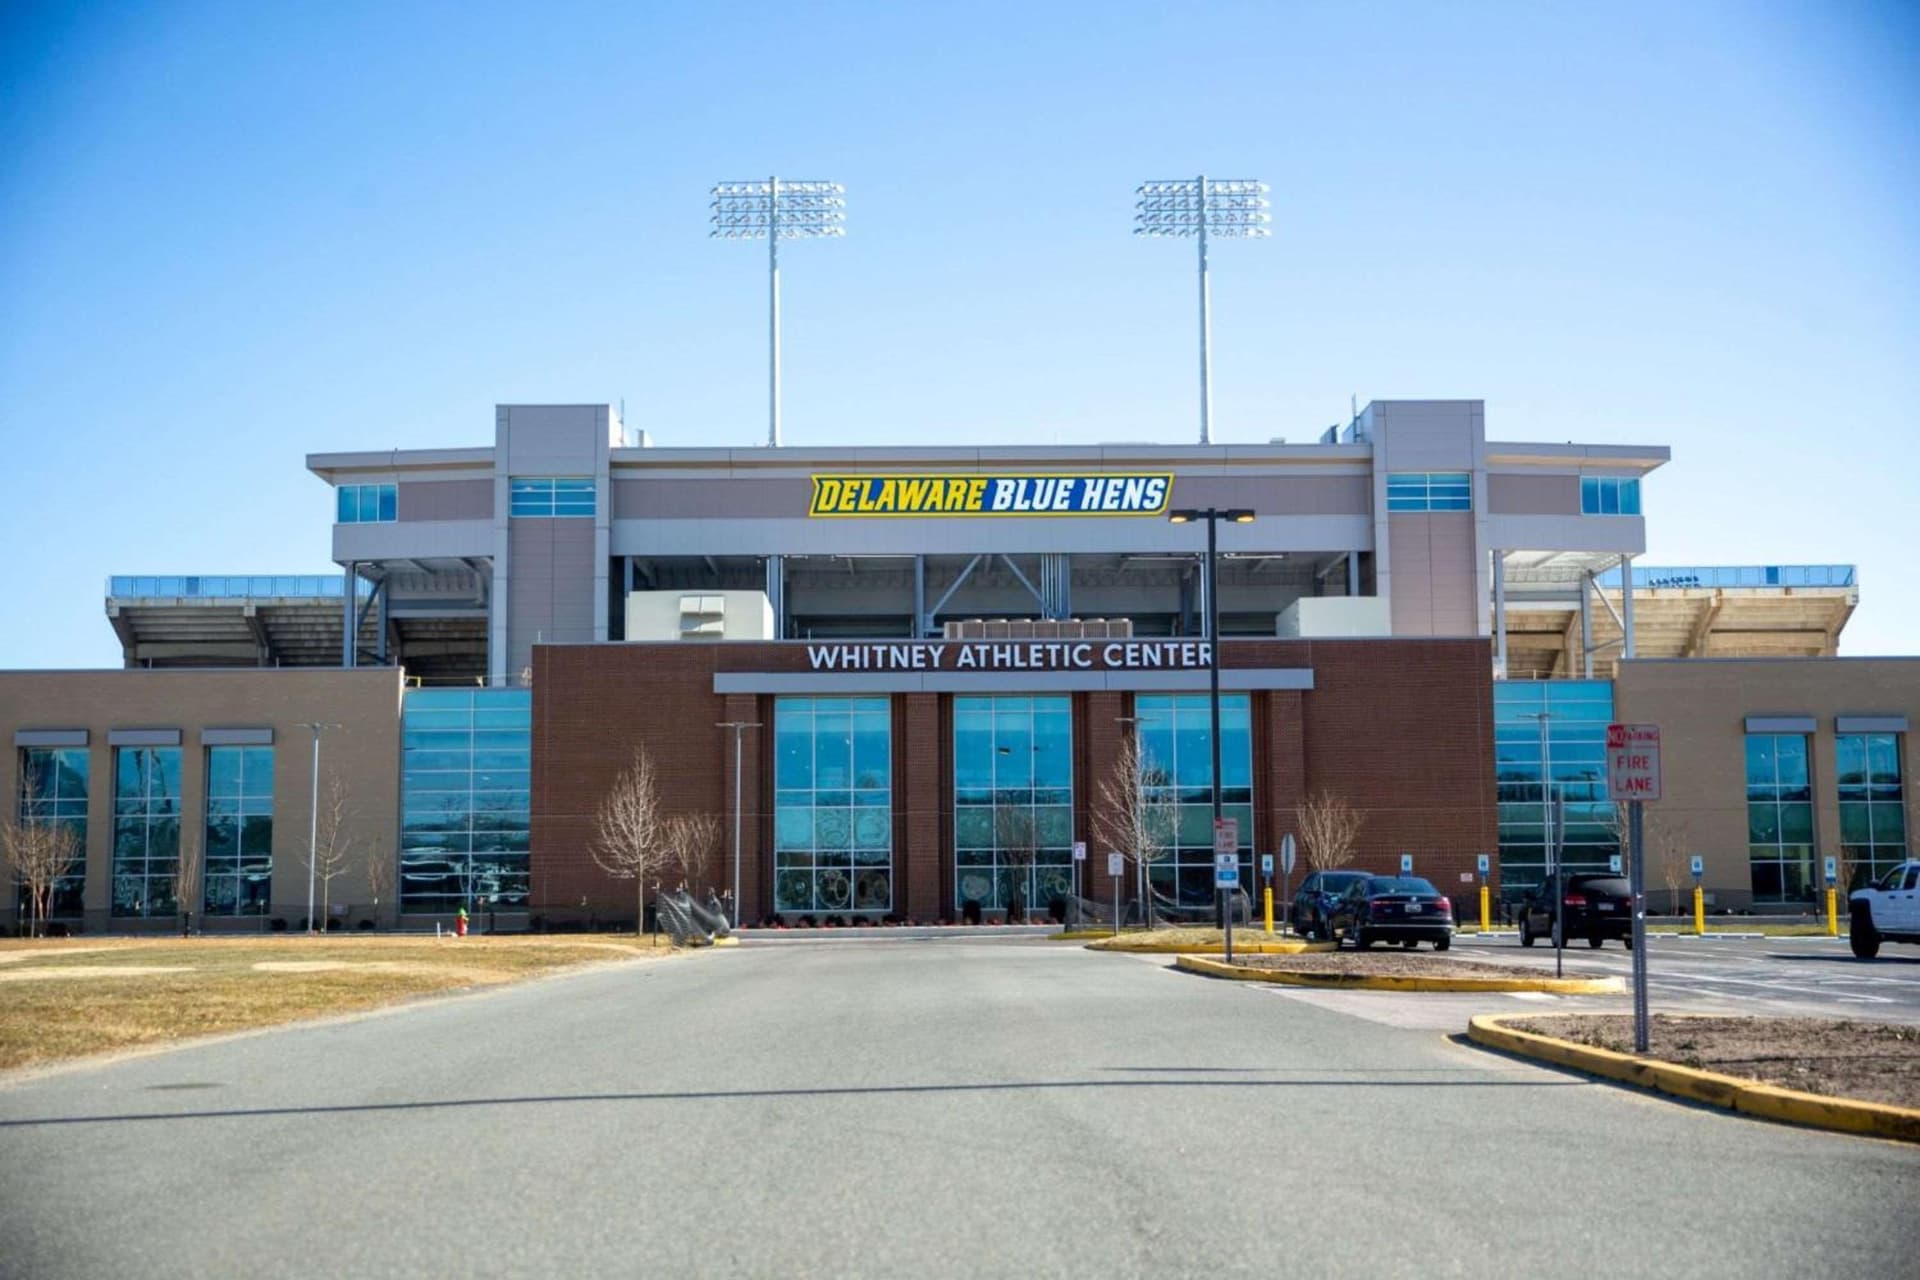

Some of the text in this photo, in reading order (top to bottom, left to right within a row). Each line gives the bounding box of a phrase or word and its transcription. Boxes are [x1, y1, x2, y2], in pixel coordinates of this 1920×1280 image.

[818, 478, 1166, 511] DELAWARE BLUE HENS
[808, 643, 1212, 669] WHITNEY ATHLETIC CENTER
[1616, 755, 1649, 769] FIRE
[1615, 777, 1652, 791] LANE
